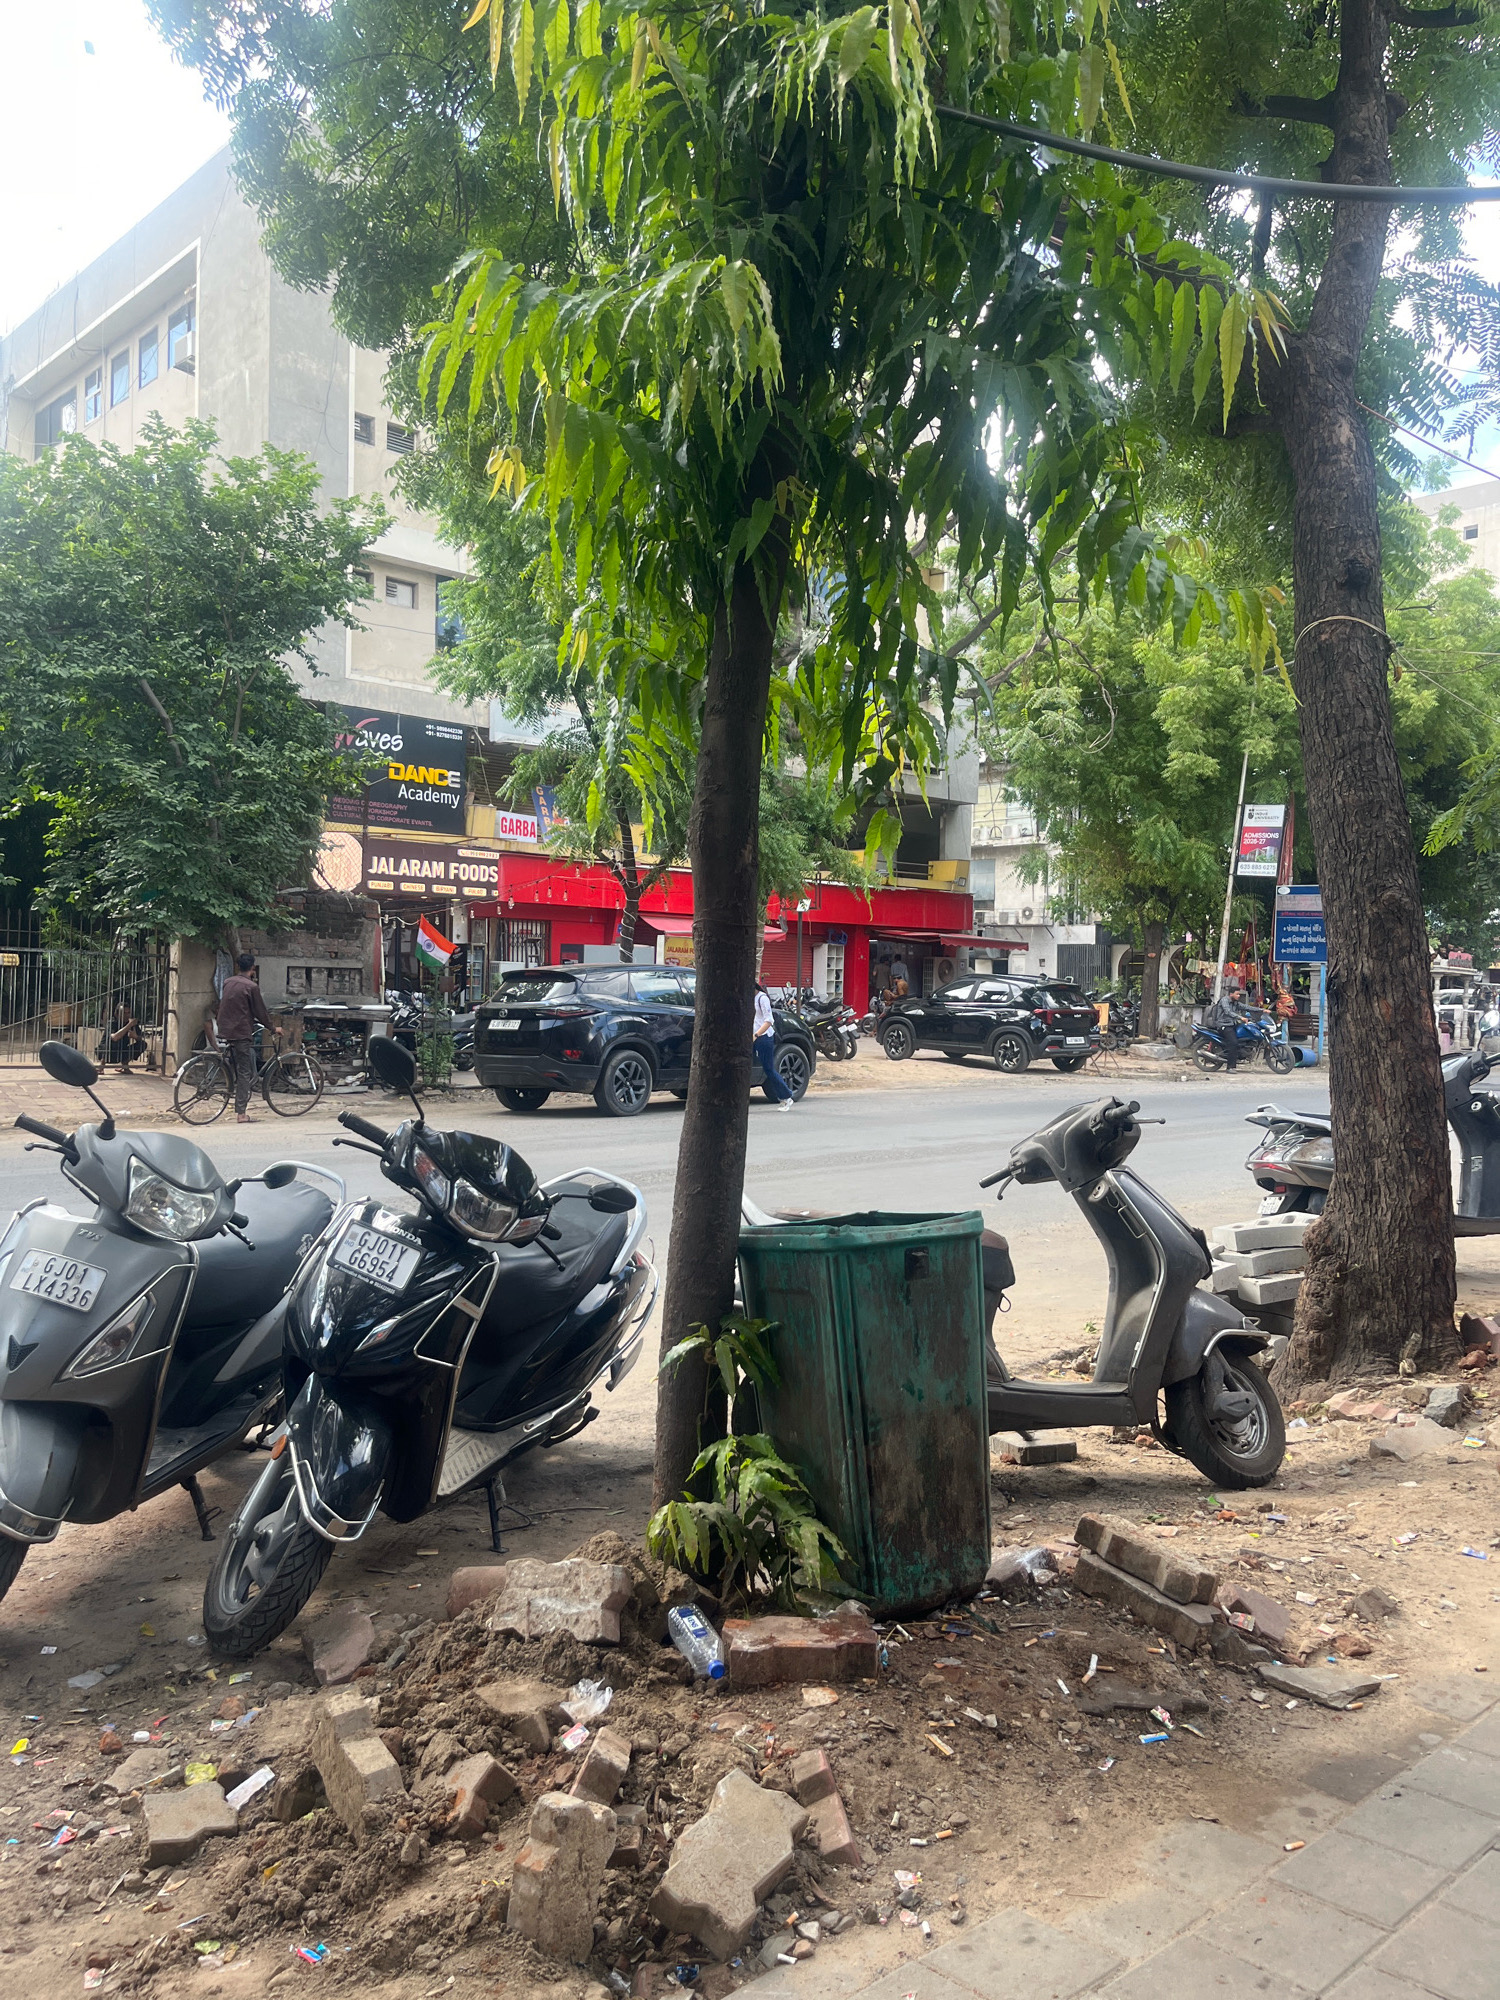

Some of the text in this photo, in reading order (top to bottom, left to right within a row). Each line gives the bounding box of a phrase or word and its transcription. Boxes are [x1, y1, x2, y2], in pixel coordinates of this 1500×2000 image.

[388, 762, 461, 788] DANCE
[332, 803, 364, 812] CELEBRITY
[361, 799, 408, 811] COREOGRAPHY
[398, 783, 460, 809] Academy
[376, 815, 410, 825] CORPORATE
[500, 816, 537, 839] GARBA
[367, 856, 499, 883] JALARAM FOODS
[666, 946, 689, 954] JALARAM
[78, 1228, 104, 1242] TVS
[358, 1231, 409, 1263] GJ01Y
[44, 1257, 89, 1285] GJ01
[348, 1249, 399, 1282] G6954
[22, 1273, 92, 1307] LX4336
